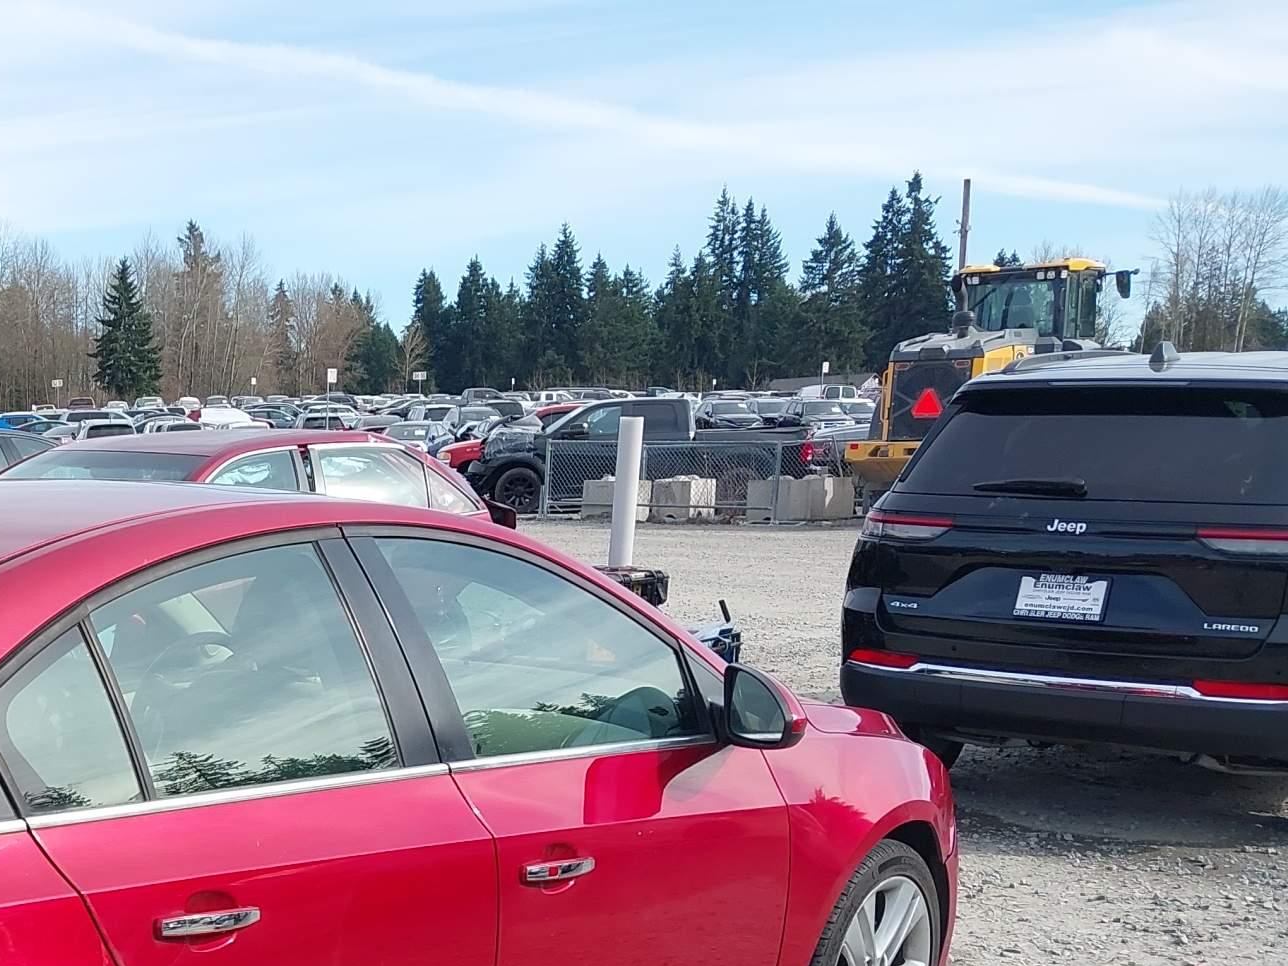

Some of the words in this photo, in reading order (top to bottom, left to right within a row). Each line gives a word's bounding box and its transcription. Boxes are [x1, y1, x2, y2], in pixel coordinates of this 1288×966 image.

[1047, 518, 1087, 535] Jeep
[1039, 574, 1088, 584] ENUMCLAW
[1033, 582, 1092, 591] Enumclaw
[889, 600, 918, 609] 4x4
[1024, 602, 1093, 612] enumclawcjd.com
[1203, 622, 1259, 633] LAREDO
